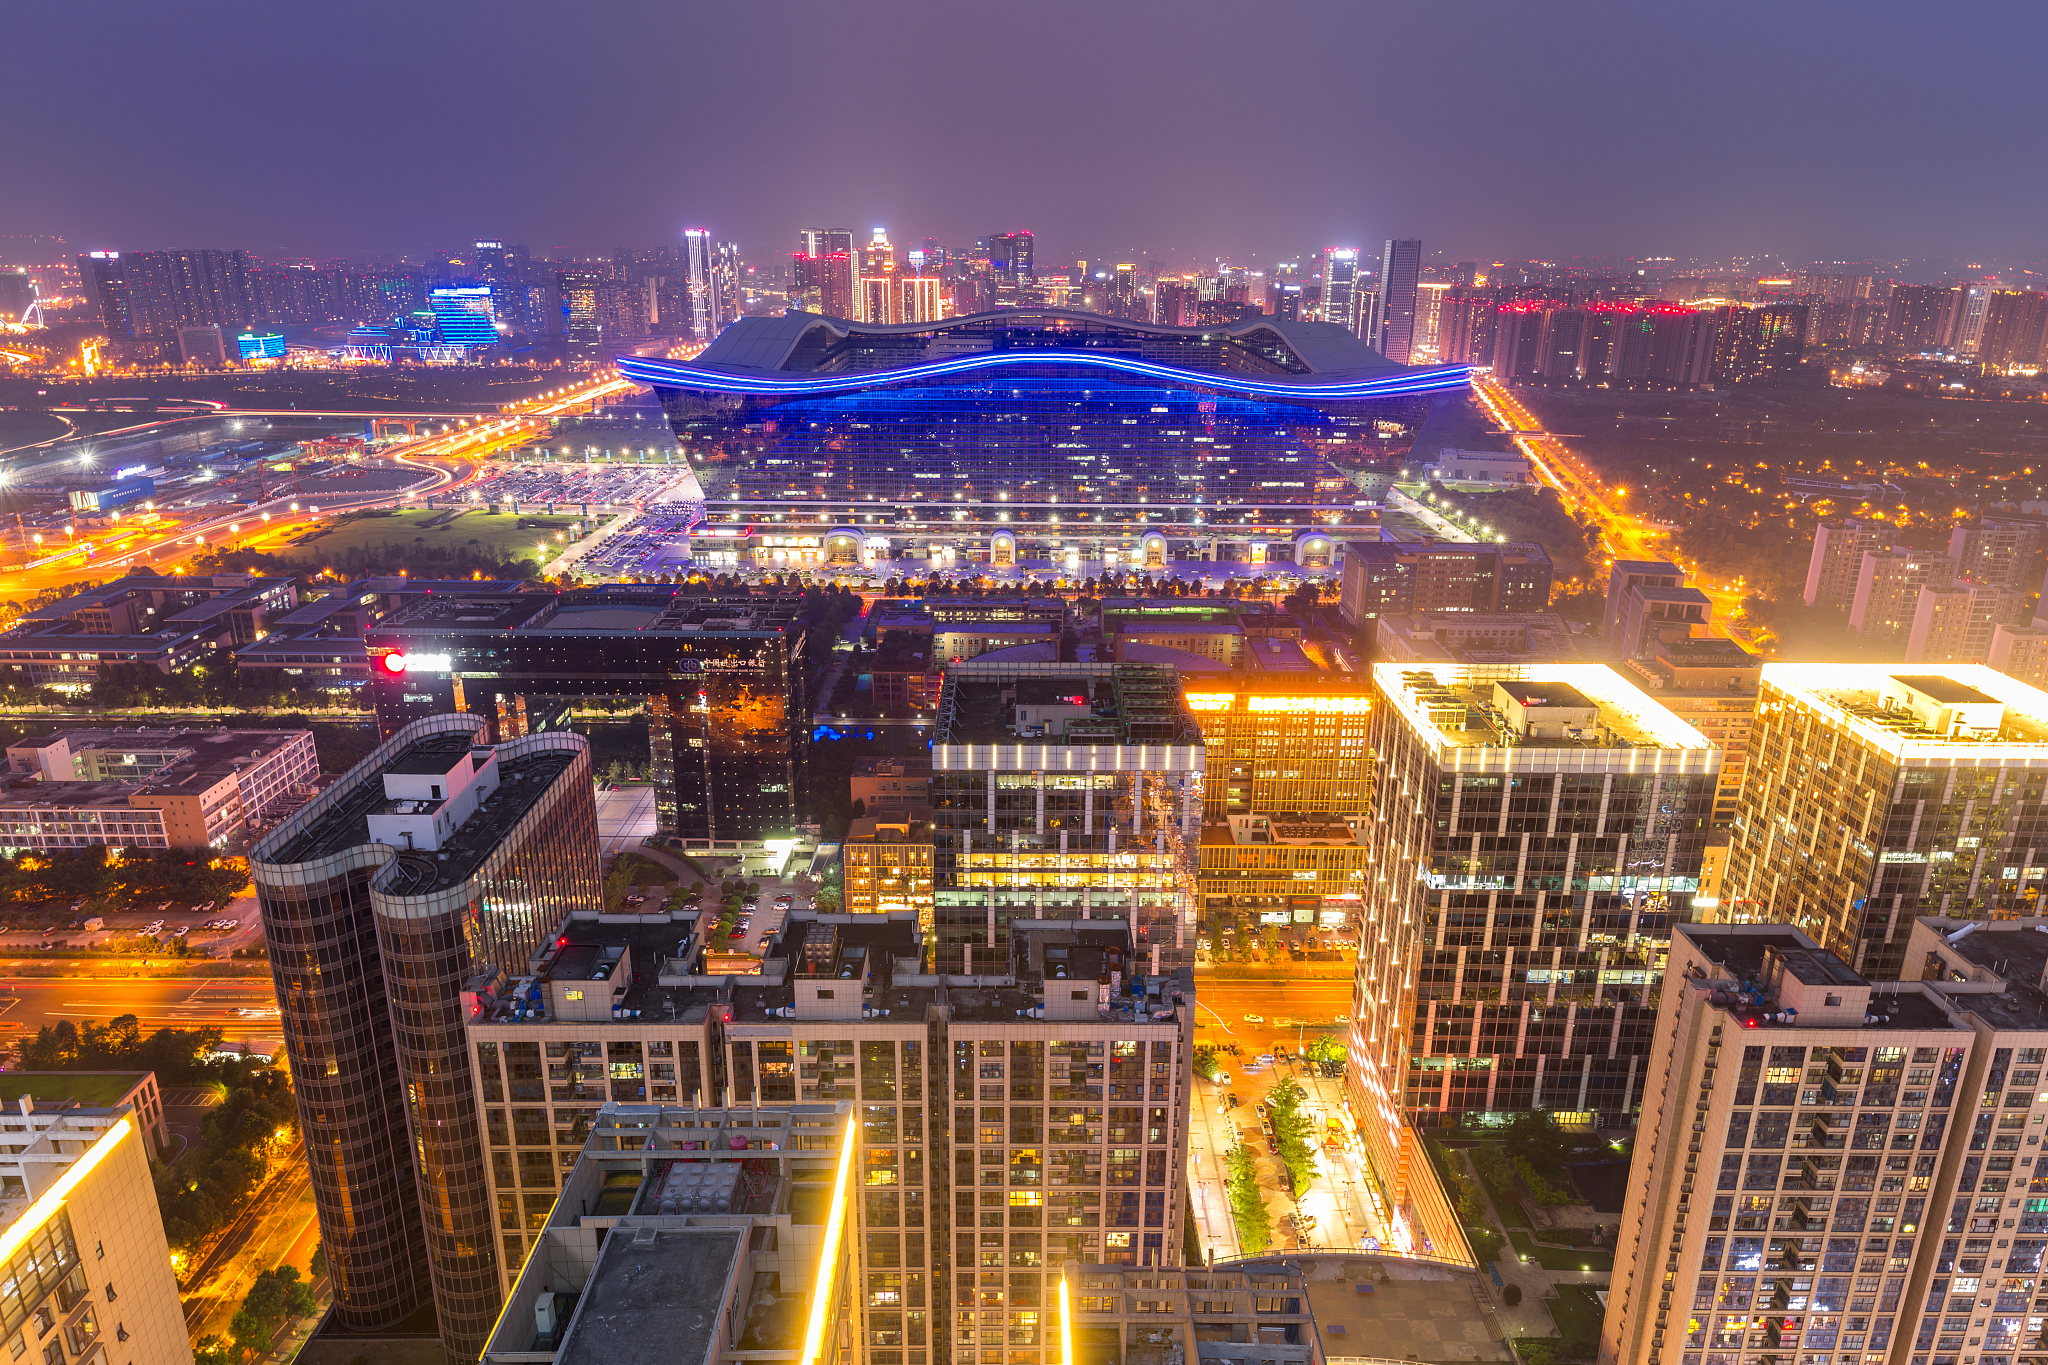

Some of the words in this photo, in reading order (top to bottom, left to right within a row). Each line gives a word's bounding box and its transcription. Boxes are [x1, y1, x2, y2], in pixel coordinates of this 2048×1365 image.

[703, 657, 766, 668] 中国进出口银行
